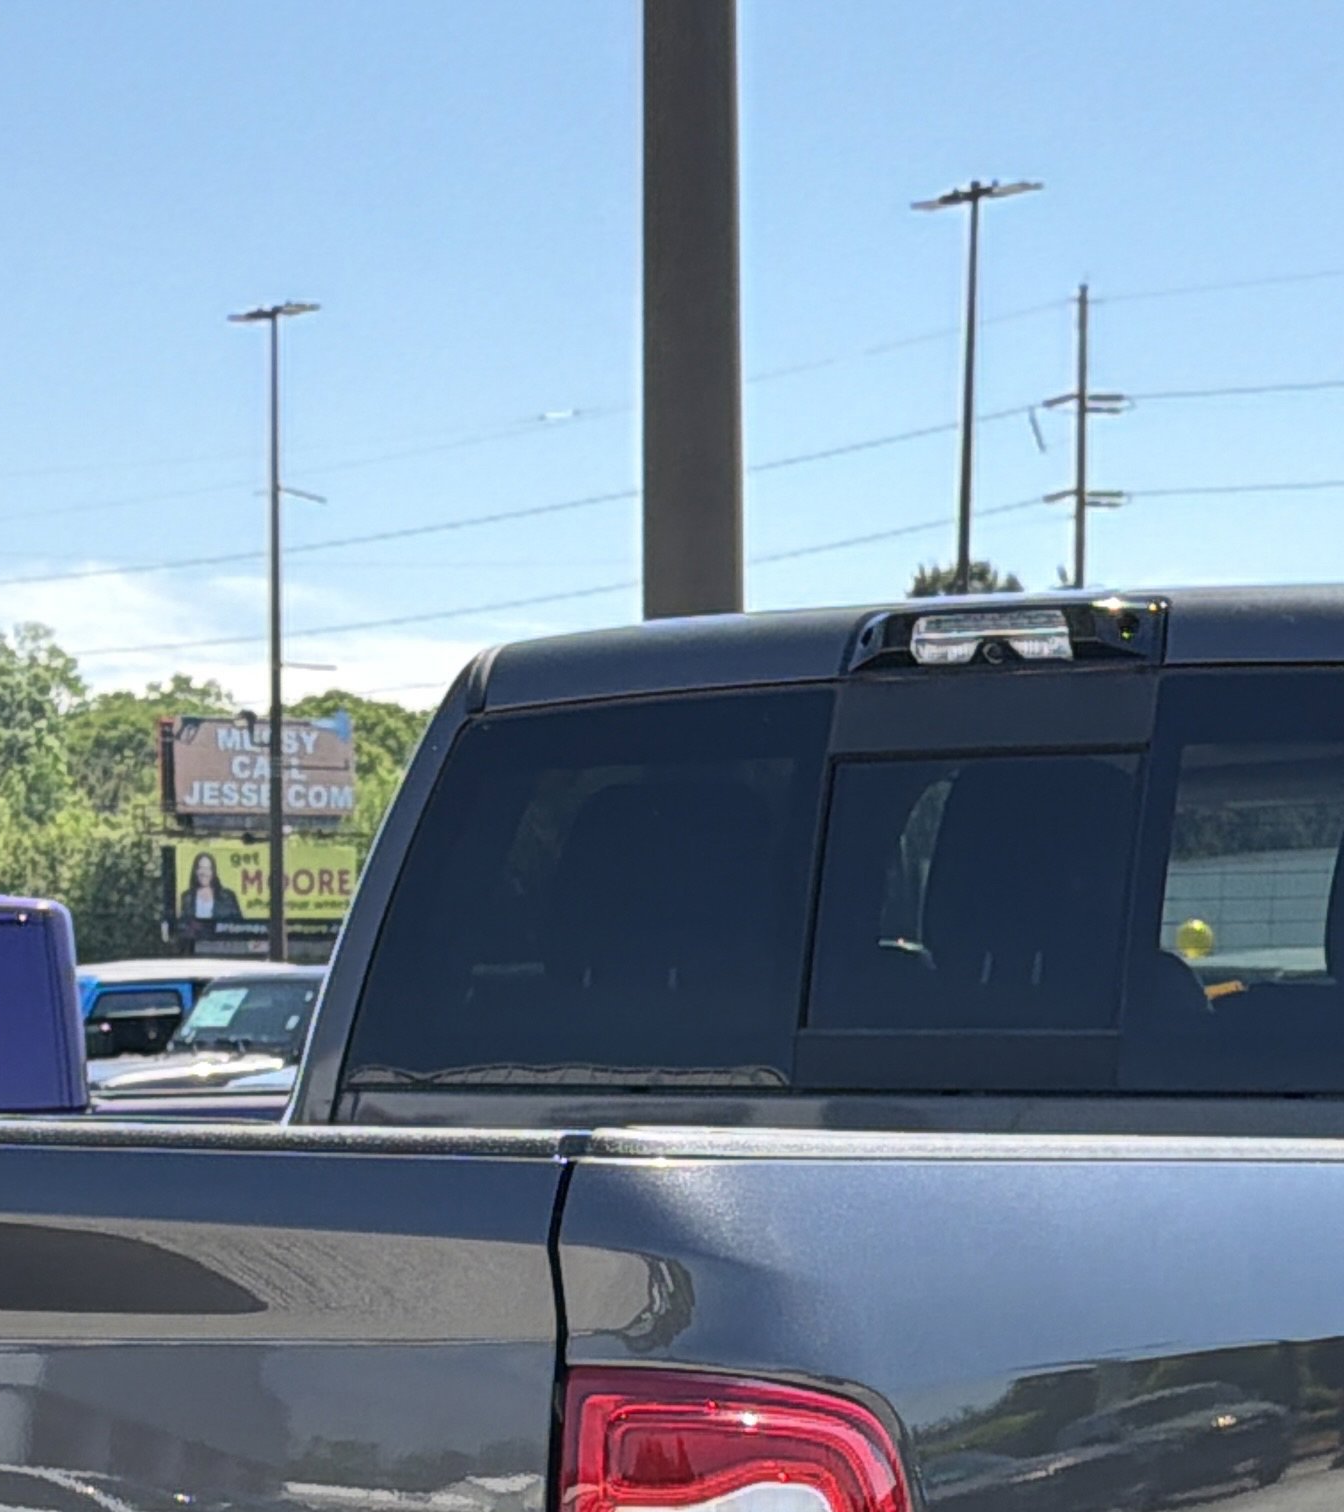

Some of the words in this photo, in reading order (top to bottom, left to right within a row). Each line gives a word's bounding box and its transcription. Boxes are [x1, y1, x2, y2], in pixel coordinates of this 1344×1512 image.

[231, 755, 307, 781] CAL
[230, 852, 260, 867] get
[241, 869, 351, 896] MORE
